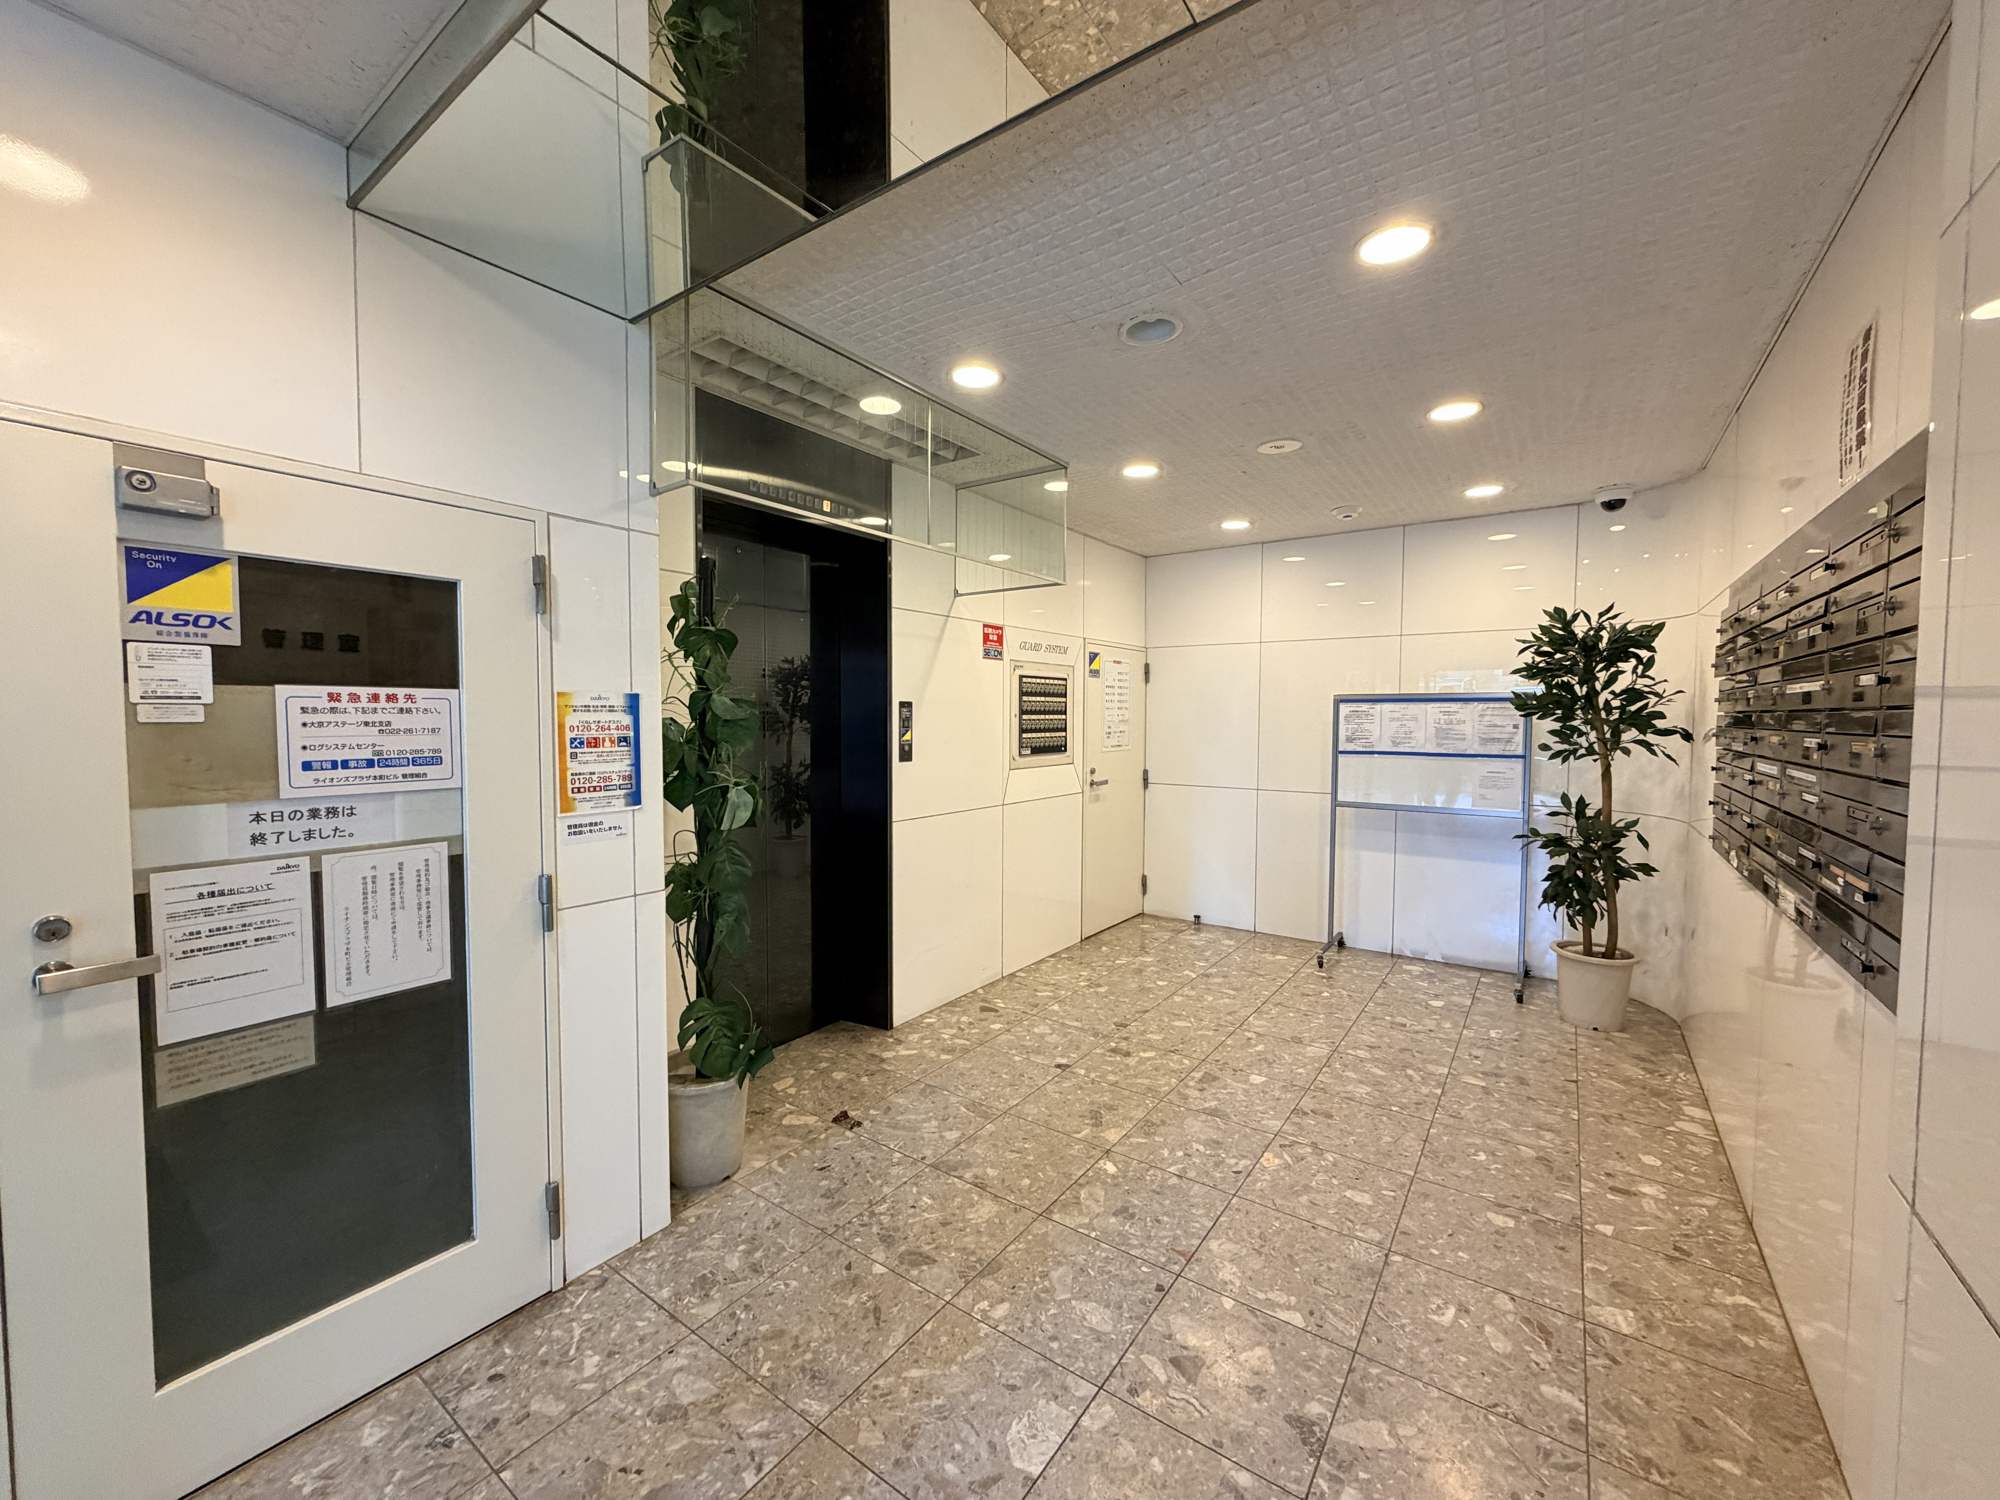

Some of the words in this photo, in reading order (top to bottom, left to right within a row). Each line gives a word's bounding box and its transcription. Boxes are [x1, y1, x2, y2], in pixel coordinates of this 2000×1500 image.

[132, 551, 177, 564] Security
[146, 560, 162, 569] On
[128, 610, 234, 631] ALSOK
[983, 648, 1003, 658] SECOM
[1019, 640, 1043, 652] GUARD
[1043, 643, 1069, 655] SYSTEM
[326, 692, 418, 704] 緊急連絡先
[299, 706, 442, 715] 緊急の際は、下記までご連絡下さい。
[308, 720, 392, 729] 大京アステージ東北支店
[569, 724, 631, 733] 0120-264-406
[384, 727, 441, 735] 022-261-7187
[308, 742, 385, 751] ログシステムセンター
[385, 748, 442, 757] 0120-285-789
[348, 760, 367, 769] 事故
[379, 757, 410, 767] 24時間
[413, 756, 441, 766] 365日
[570, 773, 633, 785] 0120-285-789
[248, 805, 358, 825] 本日の業務は
[249, 825, 356, 847] 終了しました。
